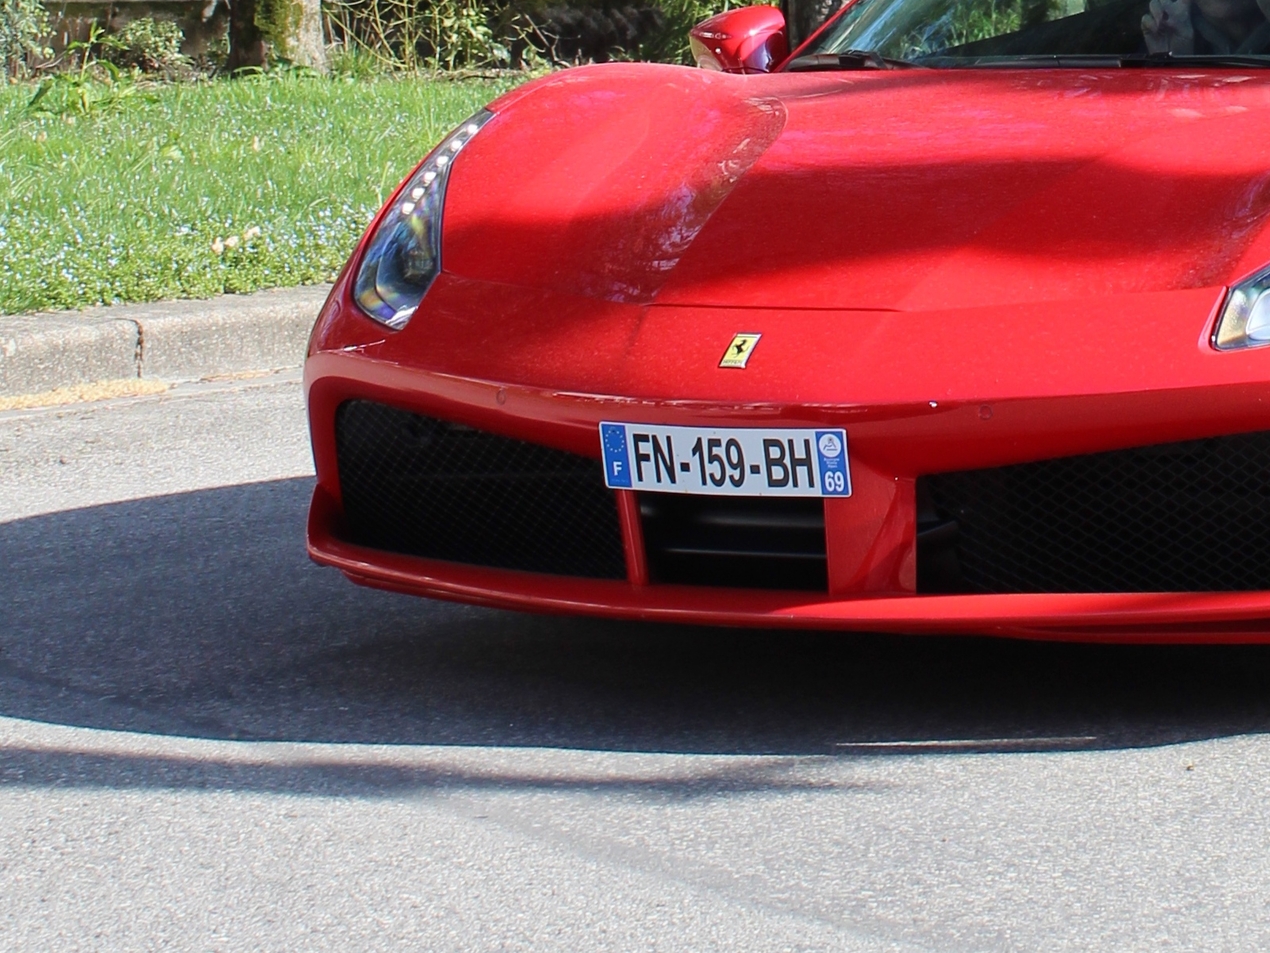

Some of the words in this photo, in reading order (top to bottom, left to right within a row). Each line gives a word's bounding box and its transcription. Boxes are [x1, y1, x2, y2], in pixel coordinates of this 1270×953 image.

[613, 461, 622, 476] F
[632, 433, 815, 488] FN-159-BH
[824, 471, 845, 492] 69
